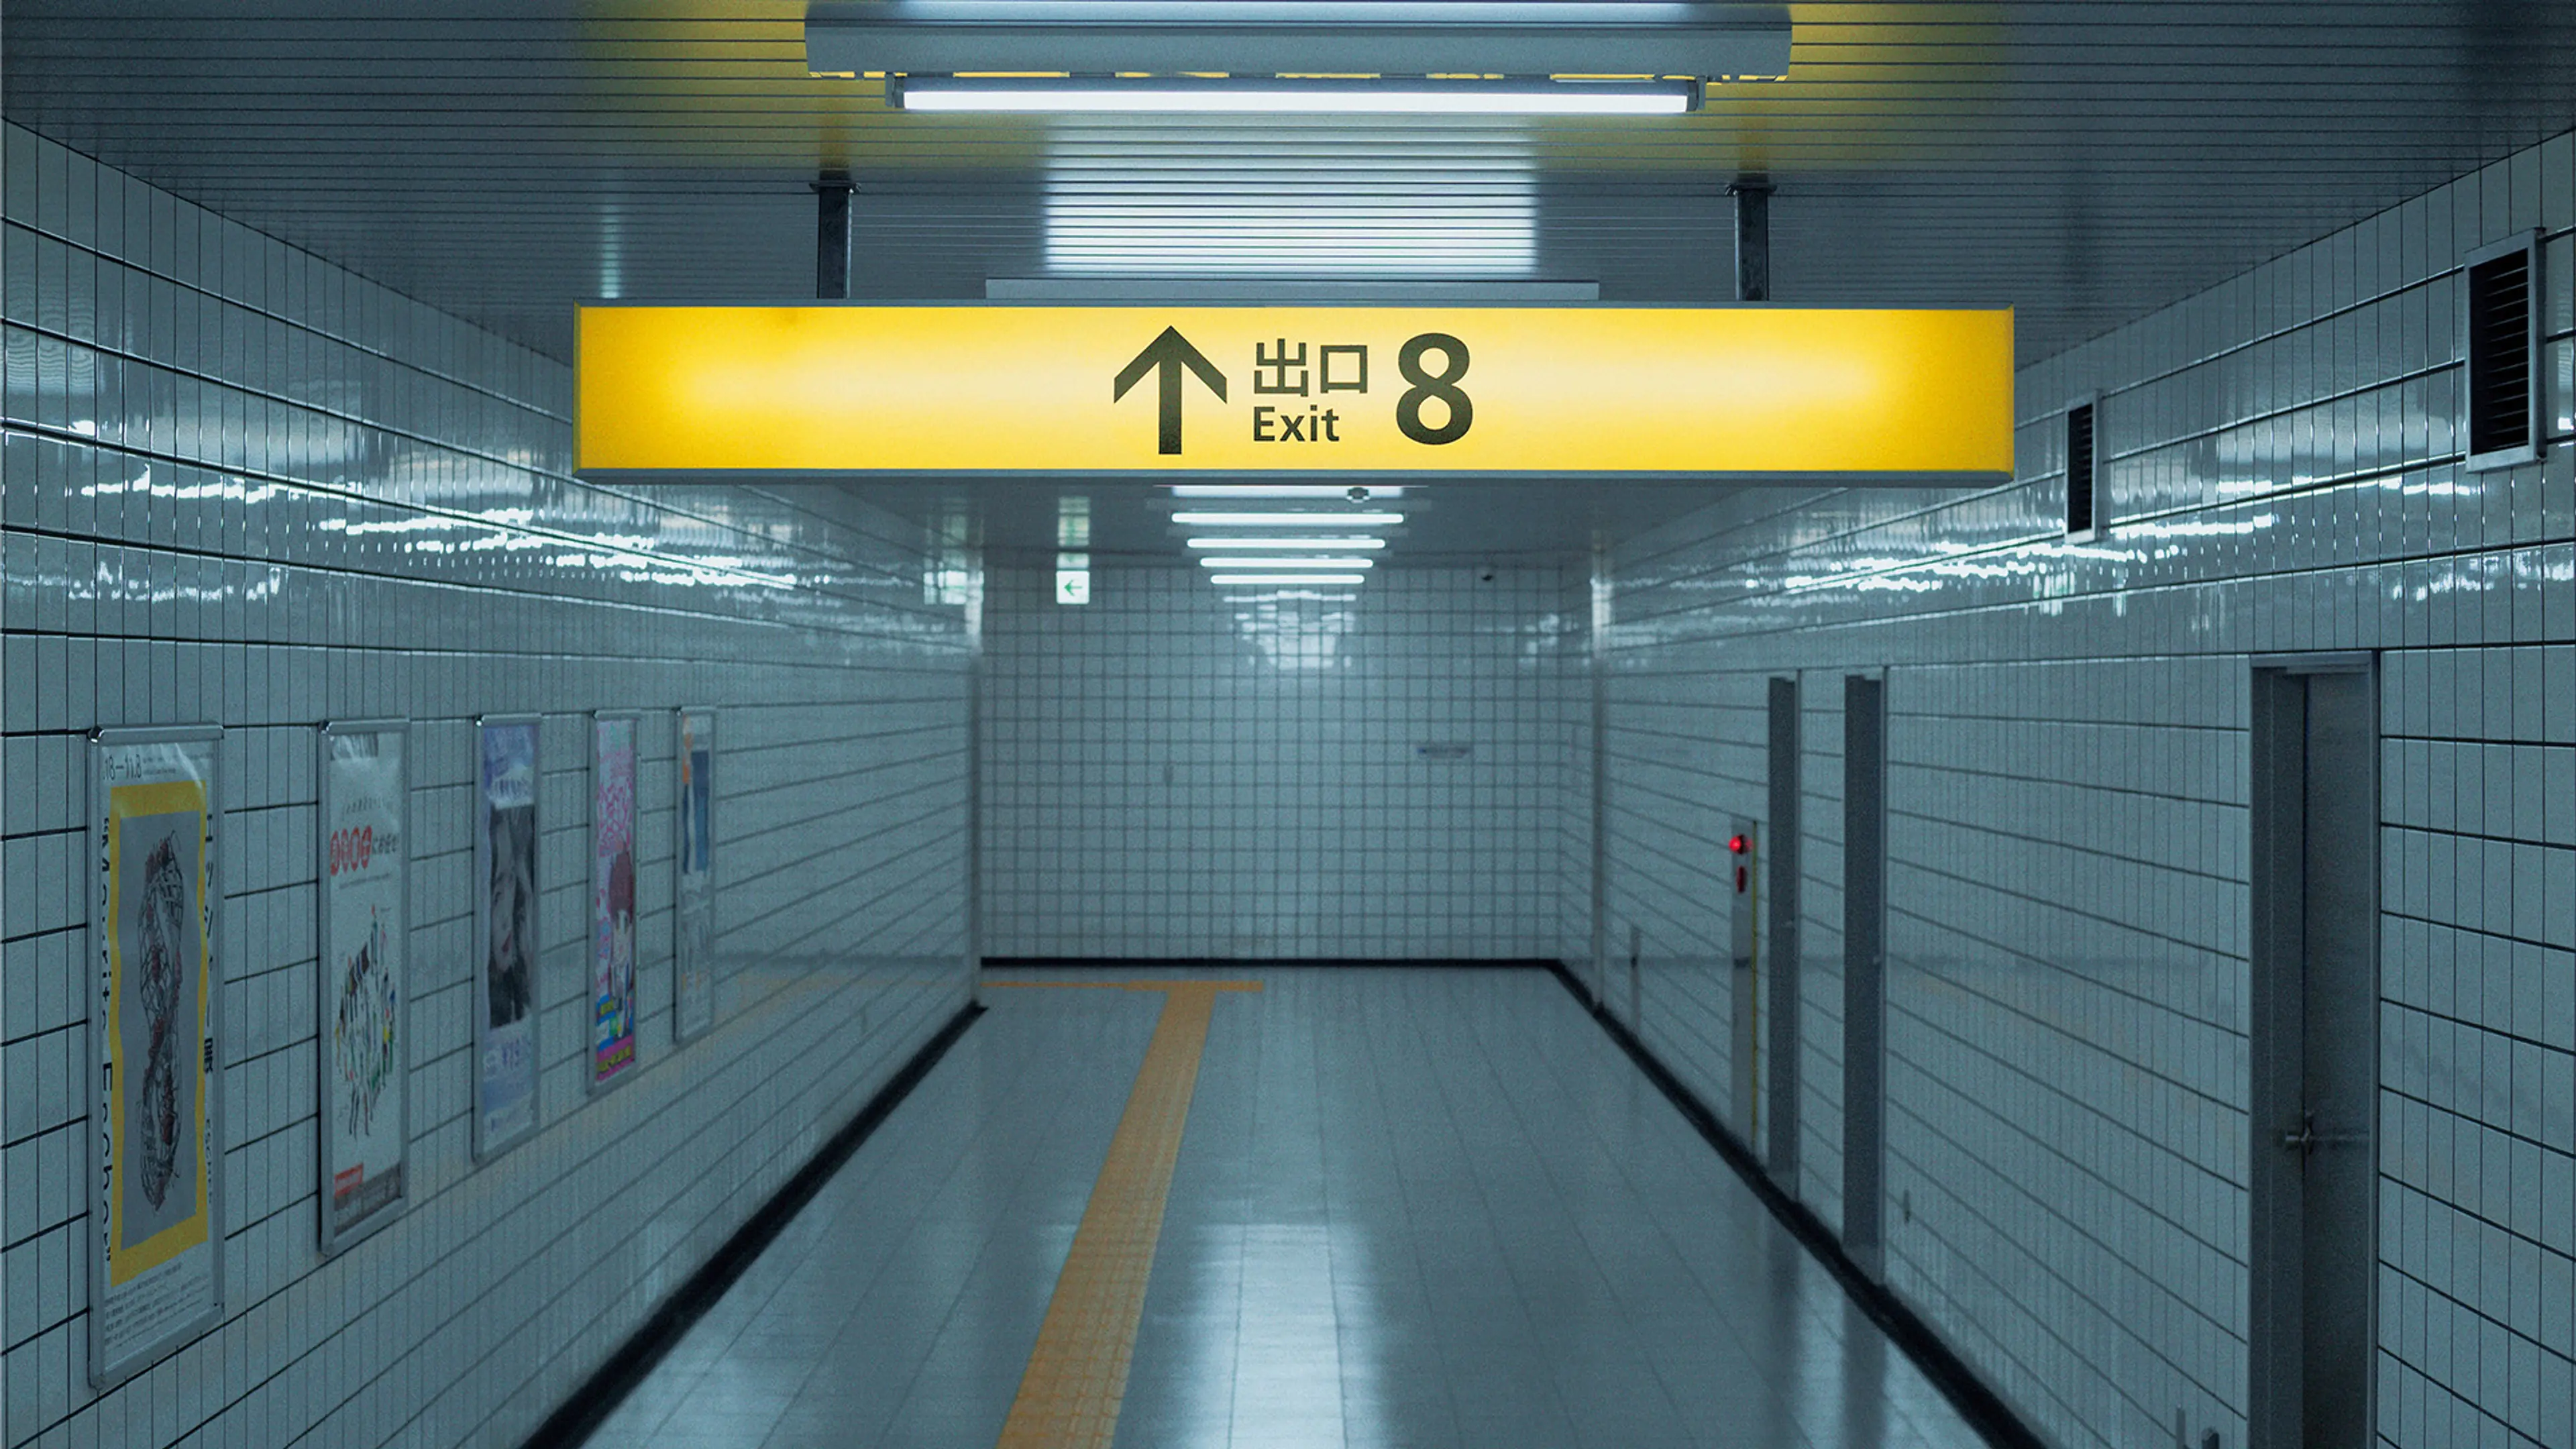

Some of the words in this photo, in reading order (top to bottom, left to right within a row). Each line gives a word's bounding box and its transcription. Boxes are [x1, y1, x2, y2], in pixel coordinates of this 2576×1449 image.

[1253, 338, 1368, 397] 出口
[1395, 332, 1473, 445] 8
[1253, 405, 1340, 442] Exit
